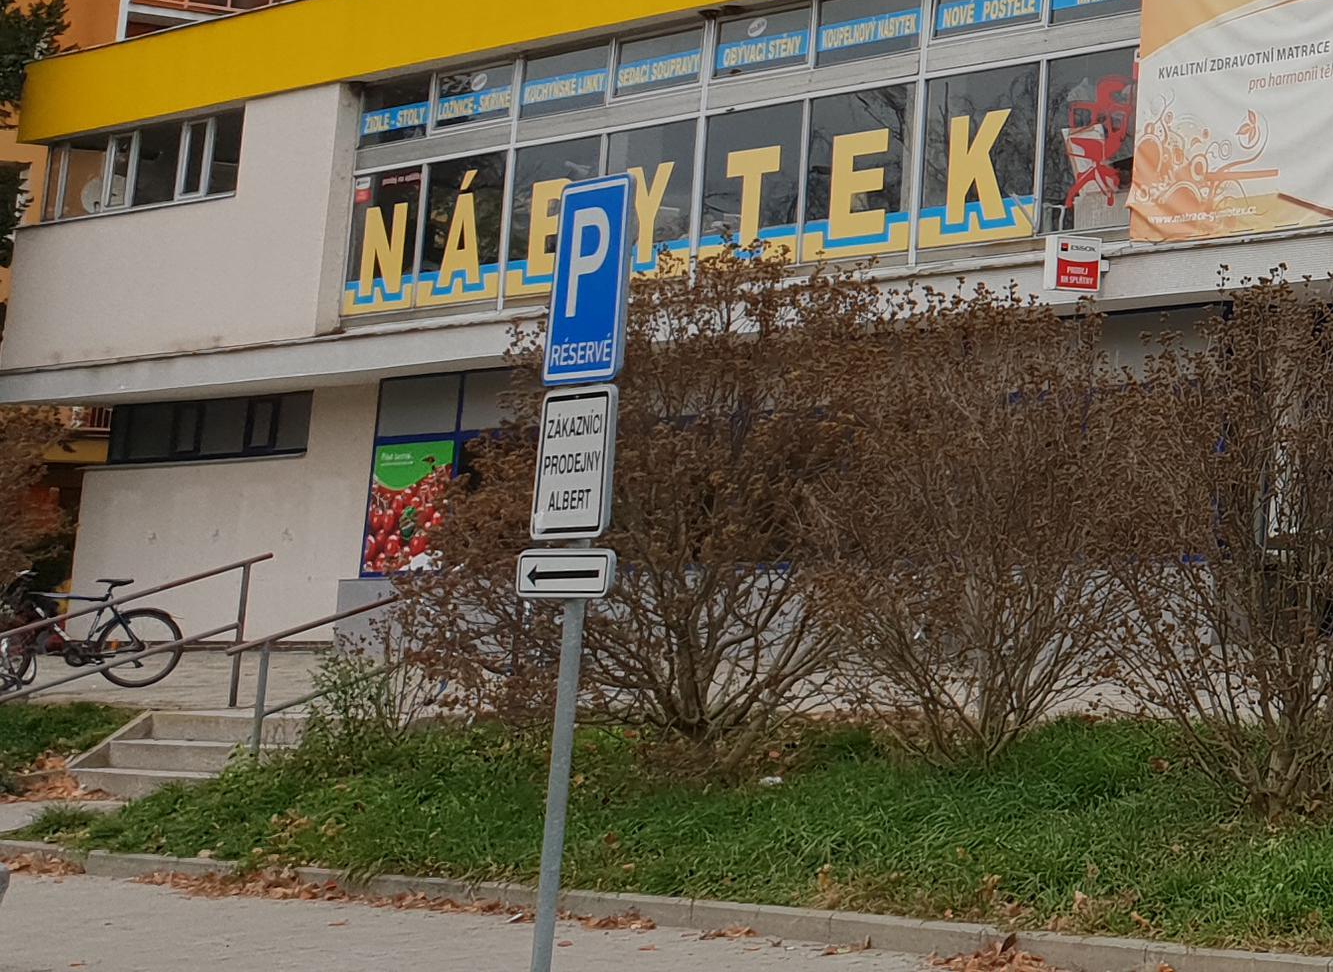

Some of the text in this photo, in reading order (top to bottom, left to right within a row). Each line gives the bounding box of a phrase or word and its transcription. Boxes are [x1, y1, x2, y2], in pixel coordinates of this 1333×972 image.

[942, 0, 975, 28] NOVÉ
[1158, 39, 1331, 80] KVALITNÍ ZDRAVOTNÍ MATRACE
[1248, 74, 1266, 93] pro
[1267, 66, 1318, 90] harmonii
[396, 108, 426, 127] STOLY
[564, 206, 611, 318] P
[550, 336, 612, 366] RÉSERVÉ
[547, 411, 602, 438] ZÁKAZNÍCI
[543, 449, 601, 476] PRODEJNY
[547, 487, 592, 512] ALBERT
